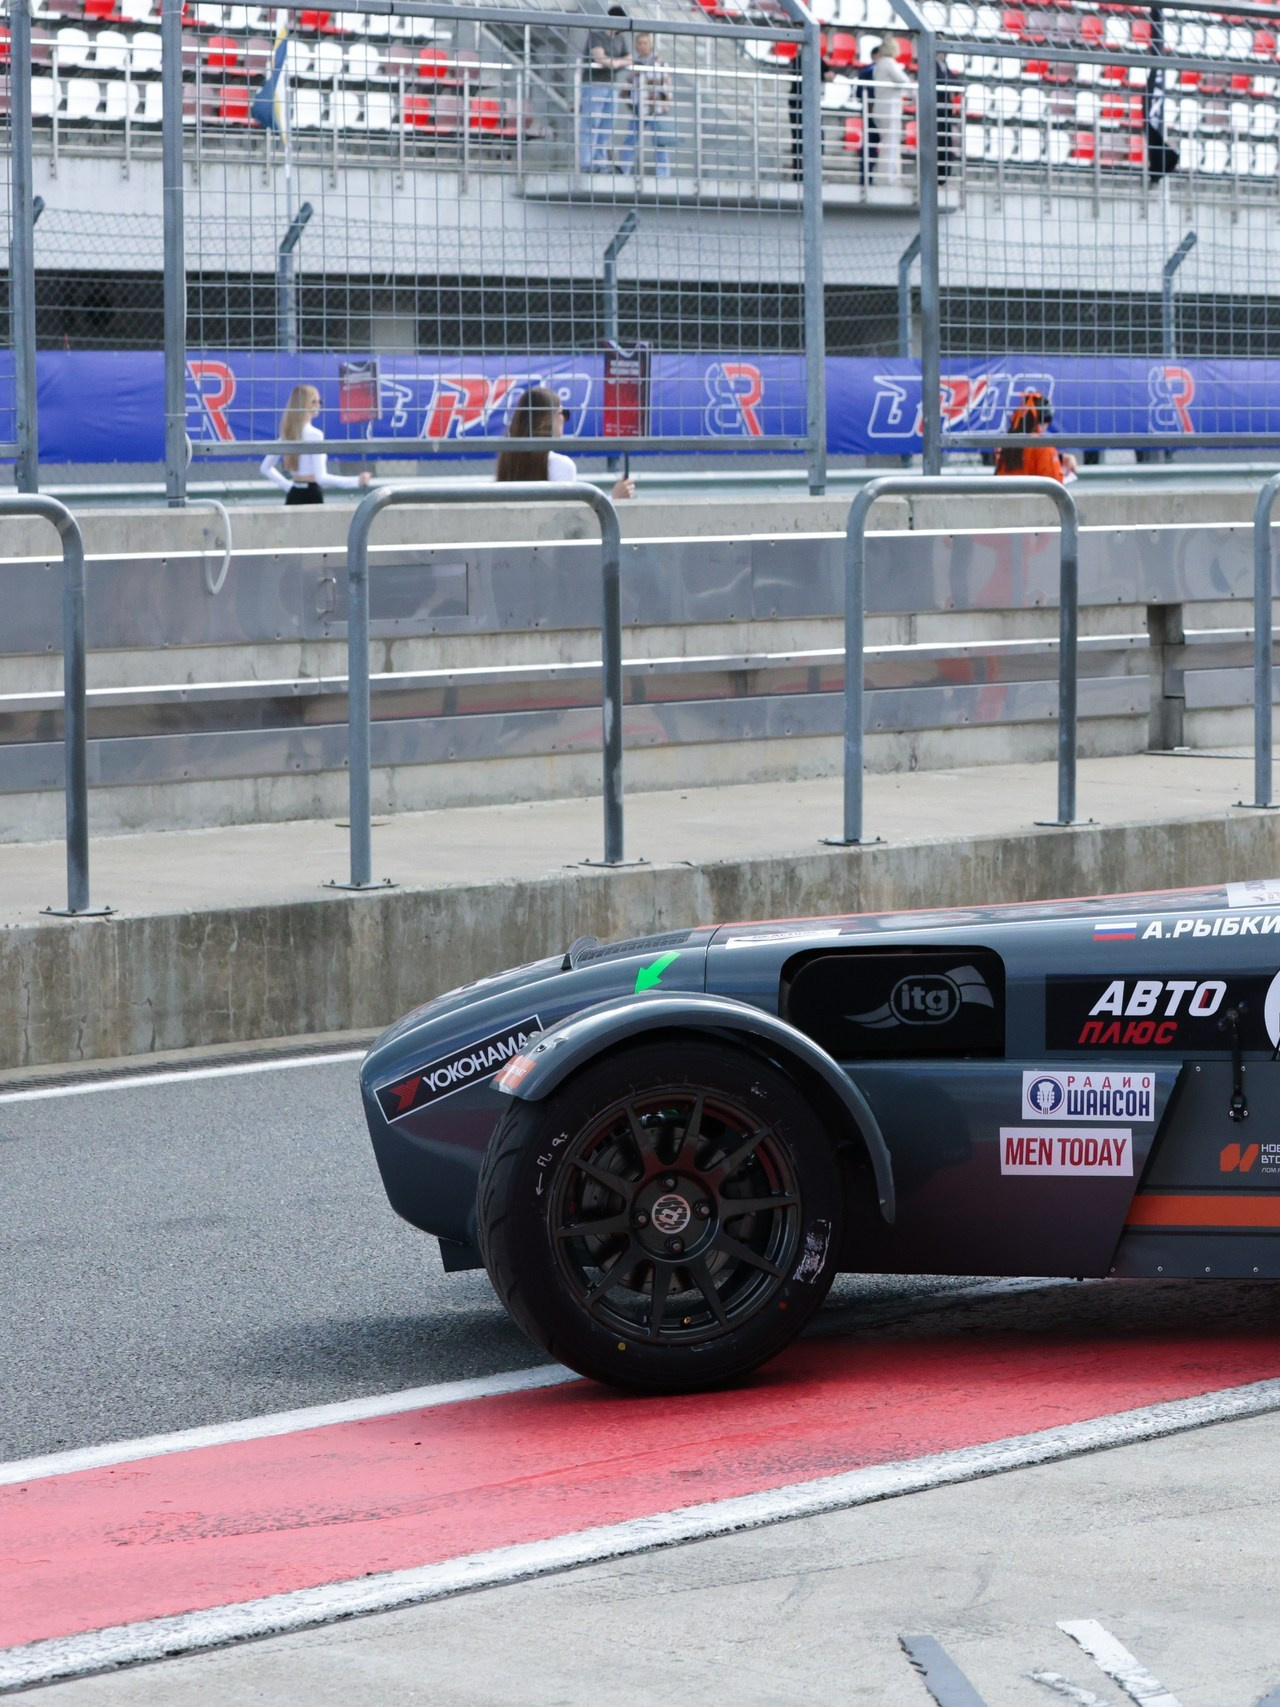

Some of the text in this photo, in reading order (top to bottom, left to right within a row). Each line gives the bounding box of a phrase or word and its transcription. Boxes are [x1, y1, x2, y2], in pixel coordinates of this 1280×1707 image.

[901, 984, 949, 1015] itg
[1088, 980, 1228, 1017] АВТО
[1077, 1021, 1179, 1045] ПЛЮС
[422, 1032, 528, 1092] YOKOHAMA
[1067, 1076, 1151, 1090] РАДИО
[1067, 1089, 1150, 1116] ШАНСОН
[1005, 1138, 1128, 1167] MEN TODAY
